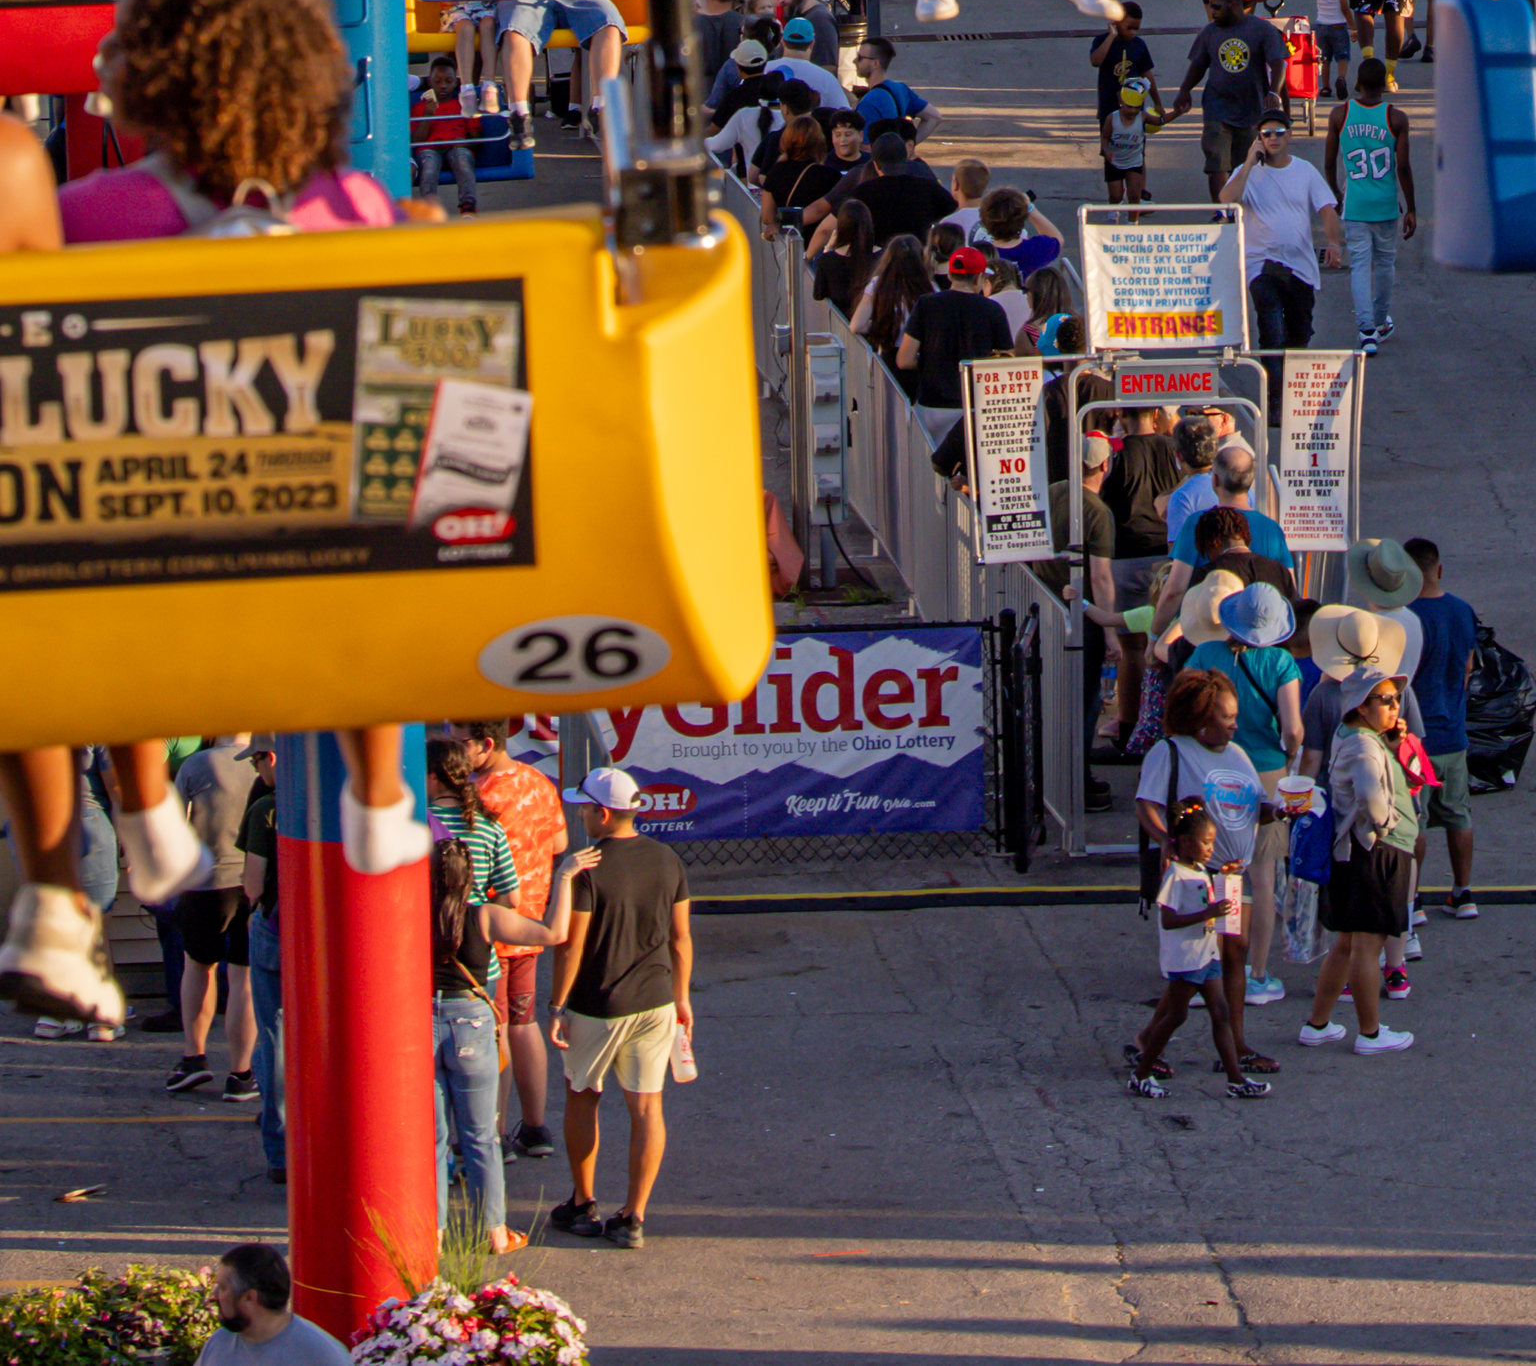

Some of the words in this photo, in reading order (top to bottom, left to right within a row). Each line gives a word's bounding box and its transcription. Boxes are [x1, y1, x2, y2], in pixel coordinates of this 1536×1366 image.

[1348, 123, 1387, 141] PIPPEN
[1347, 146, 1391, 180] 30
[1112, 234, 1120, 242] IF
[1124, 234, 1143, 243] YOU
[1147, 234, 1164, 242] ARE
[1168, 233, 1208, 242] CAUGHT
[1103, 245, 1153, 253] BOUNCING
[1174, 244, 1218, 253] SPITTING
[1112, 256, 1129, 264] OFF
[1133, 256, 1150, 264] THE
[1153, 256, 1171, 264] SKY
[1175, 255, 1209, 264] GLIDER
[1132, 266, 1150, 274] YOU
[1154, 266, 1176, 274] WILL
[1181, 266, 1192, 274] BE
[1112, 277, 1159, 285] ESCORTED
[1164, 277, 1192, 285] FROM
[1194, 276, 1212, 284] THE
[1115, 288, 1160, 296] GROUNDS
[1164, 286, 1211, 296] WITHOUT
[1114, 299, 1152, 307] RETURN
[1155, 297, 1211, 307] PRIVILEGES
[1114, 314, 1217, 334] ENTRANCE
[976, 373, 1000, 383] FOR
[1007, 370, 1039, 381] YOUR
[1121, 373, 1212, 394] ENTRANCE
[984, 383, 1032, 395] SAFETY
[986, 398, 1031, 406] EXPECTANT
[96, 452, 200, 485] APRIL
[209, 450, 250, 480] 24
[999, 458, 1026, 474] NO
[97, 491, 194, 522] SEPT.
[201, 489, 247, 518] 10,
[256, 481, 339, 514] 2023
[513, 625, 641, 686] 26
[672, 741, 739, 761] Brought
[743, 740, 759, 757] to
[763, 740, 795, 760] you
[797, 736, 818, 757] by
[822, 736, 848, 754] the
[852, 735, 891, 751] Ohio
[896, 733, 956, 754] Lottery
[785, 794, 824, 818] Keep
[843, 787, 881, 814] Fun
